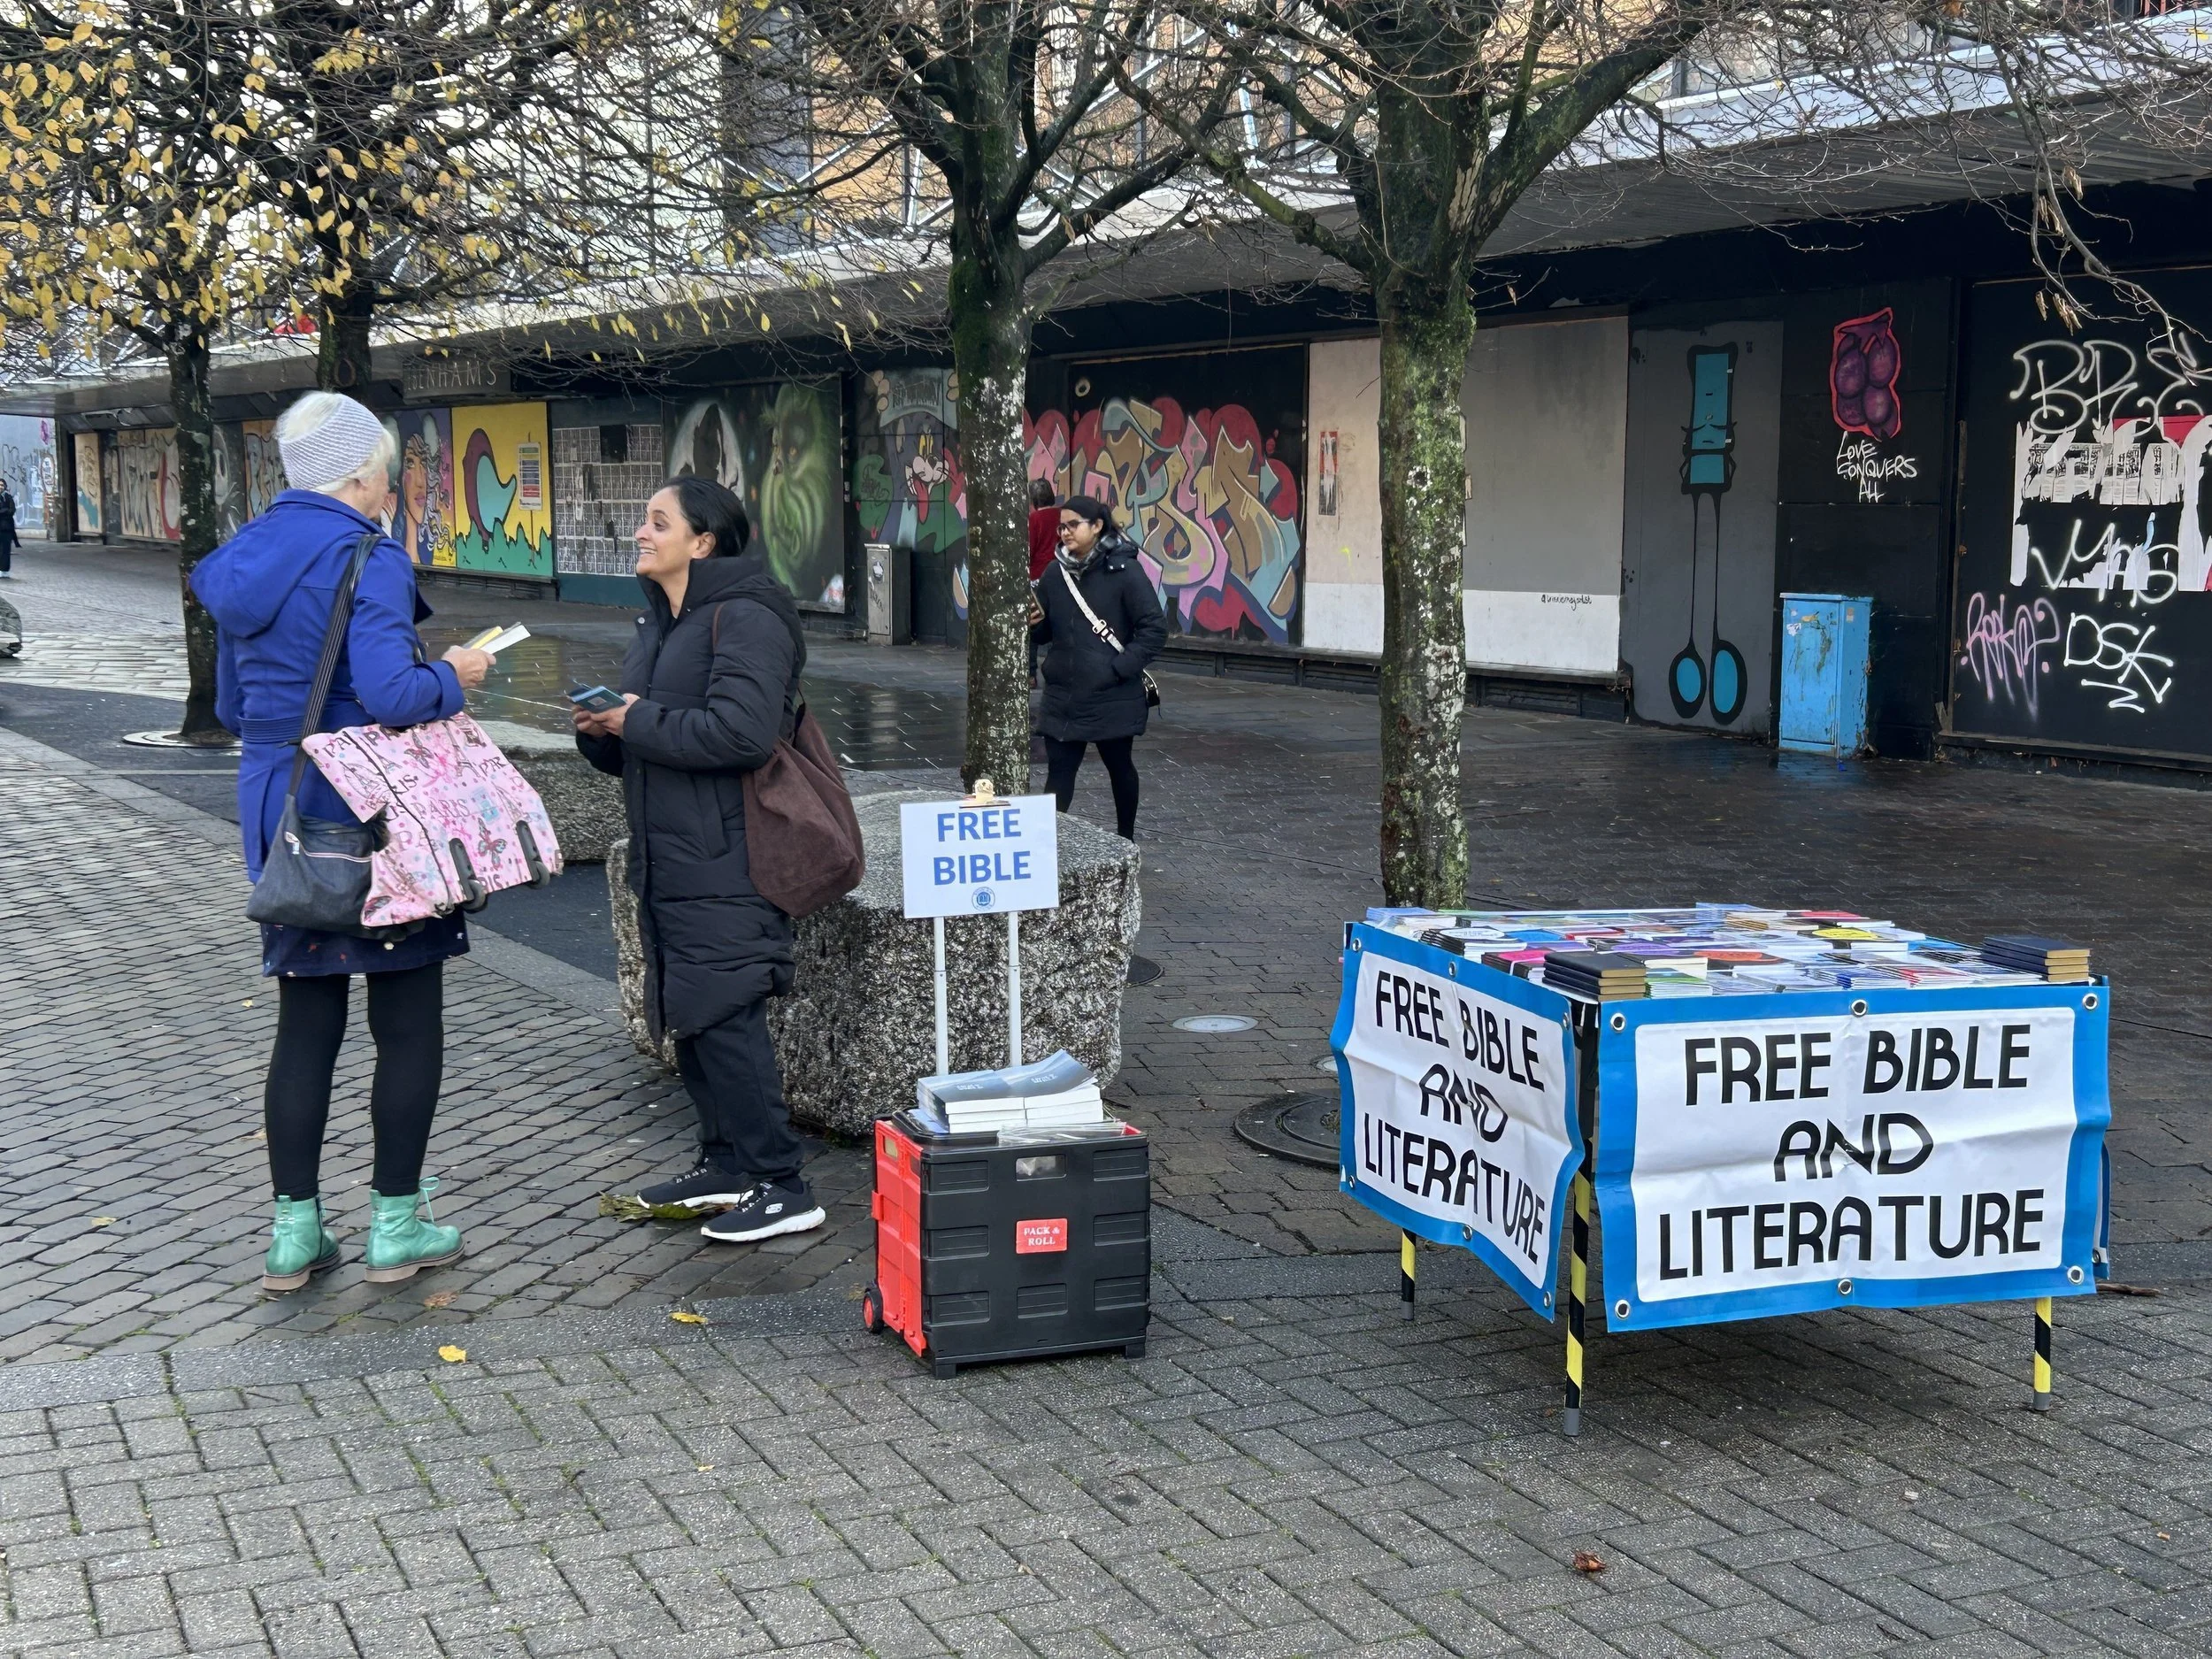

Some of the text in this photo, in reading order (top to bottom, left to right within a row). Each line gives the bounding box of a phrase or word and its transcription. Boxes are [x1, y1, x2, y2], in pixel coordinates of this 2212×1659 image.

[1837, 431, 1878, 461] LOVE
[1837, 455, 1917, 482] CONQUERS
[1859, 477, 1886, 503] ALL
[937, 809, 1022, 842] FREE
[933, 850, 1032, 886] BIBLE
[1375, 970, 1545, 1093] FREE BIBLE
[1685, 1024, 2031, 1106] FREE BIBLE
[1418, 1063, 1509, 1143] AND
[1773, 1112, 1934, 1181] AND
[1364, 1112, 1545, 1265] LITERATURE
[1024, 1226, 1050, 1235] PACK
[1028, 1236, 1056, 1246] ROLL
[1659, 1188, 2044, 1280] LITERATURE
